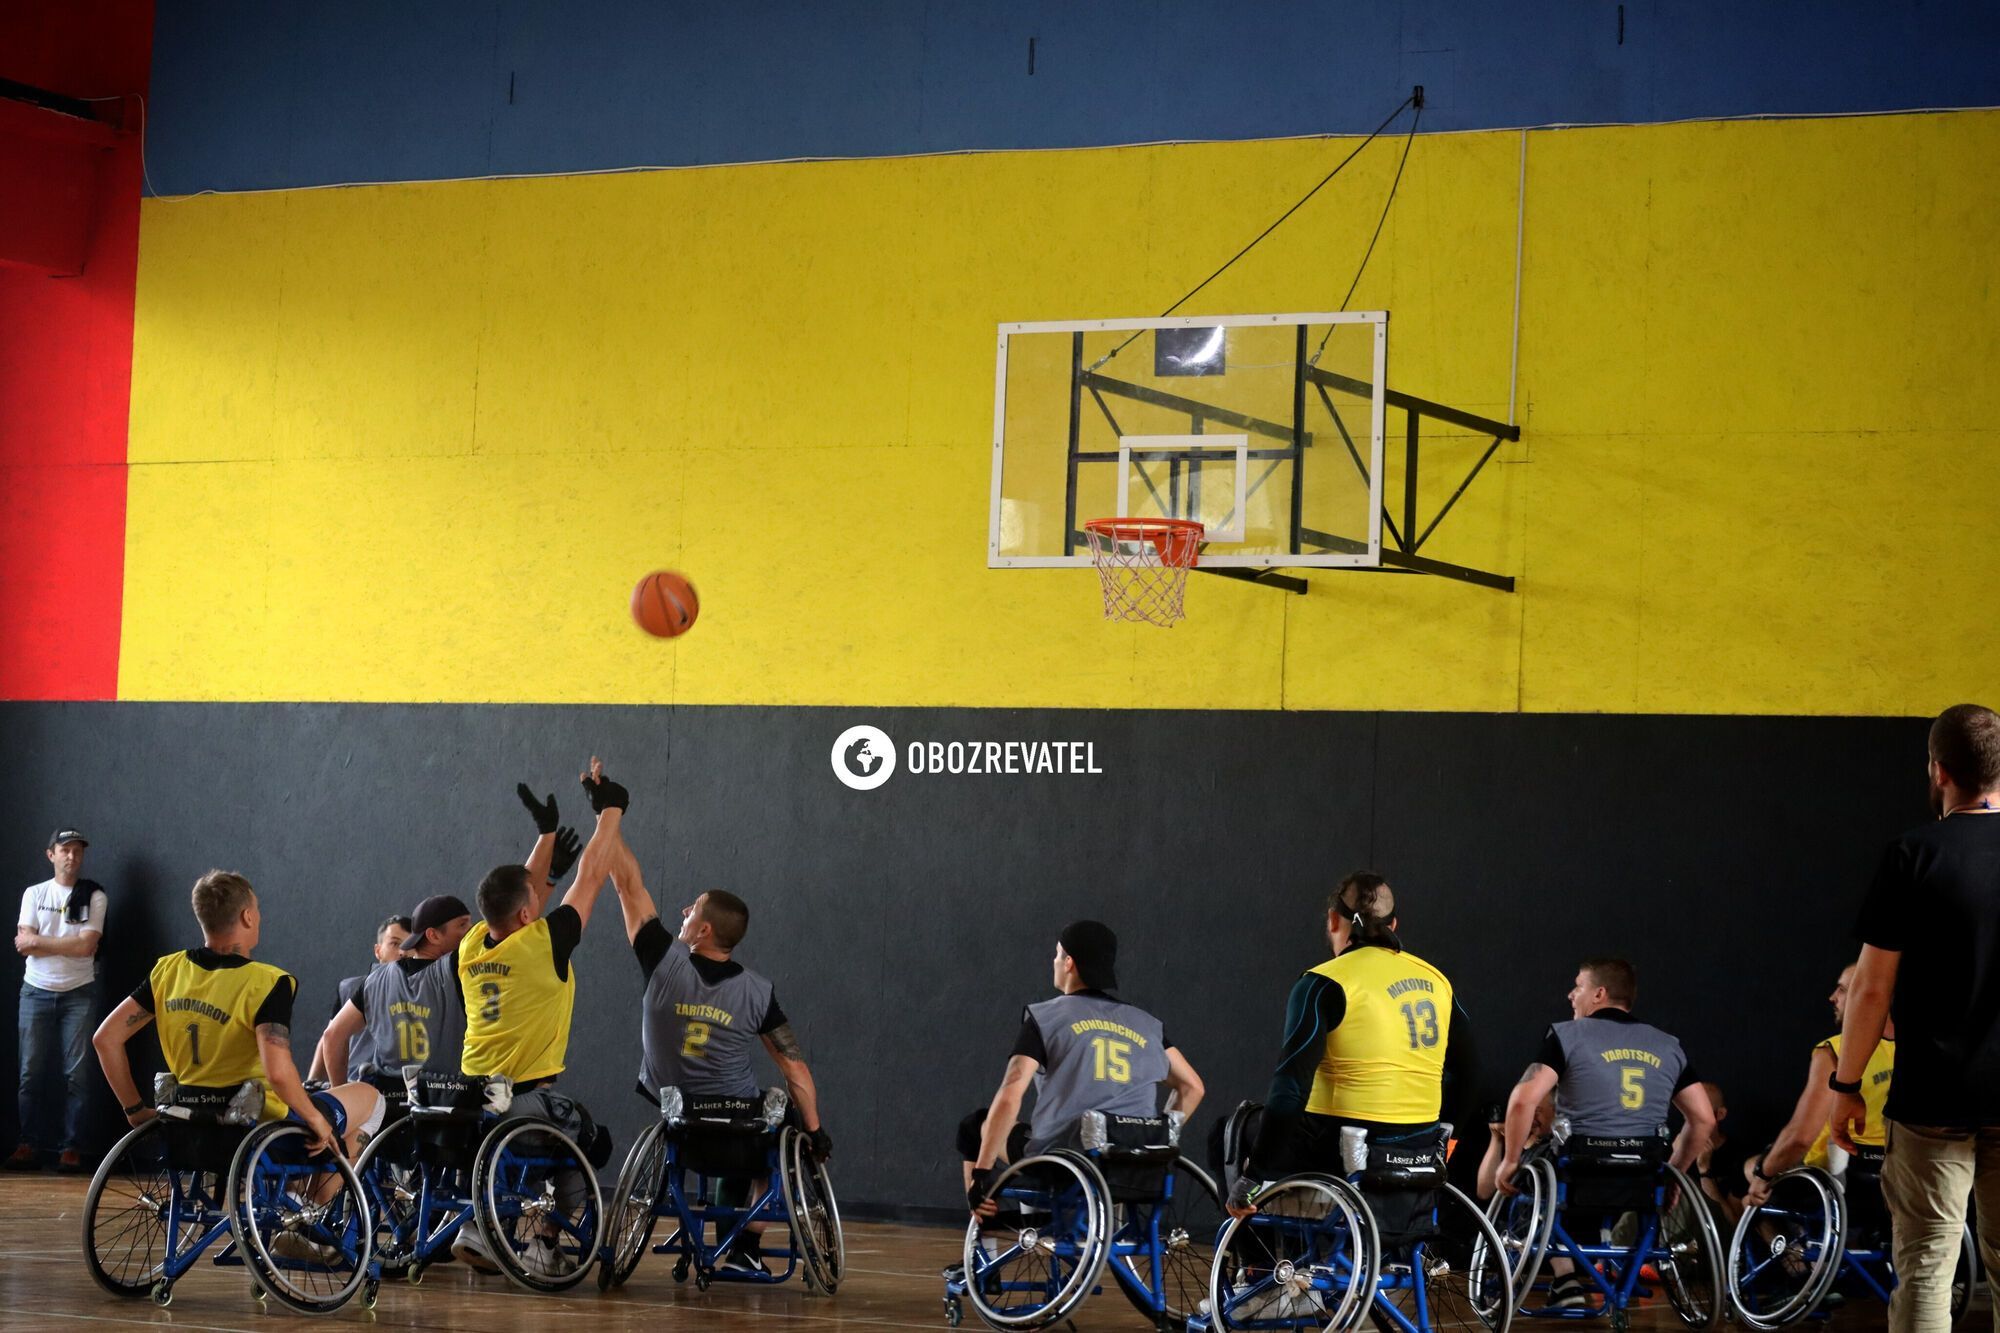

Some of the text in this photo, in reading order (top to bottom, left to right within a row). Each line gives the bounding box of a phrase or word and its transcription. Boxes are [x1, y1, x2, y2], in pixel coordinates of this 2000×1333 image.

[467, 961, 512, 978] LUCHKIV
[1386, 978, 1434, 1000] MAKOVEI
[165, 997, 232, 1026] PONOMAROV
[674, 1003, 733, 1026] ZARITSKYI
[1400, 1000, 1439, 1049] 13
[186, 1023, 200, 1065] 1
[395, 1020, 430, 1062] 16
[681, 1020, 711, 1057] 2
[1071, 1018, 1148, 1049] BONDARCHUK
[1091, 1037, 1132, 1084] 15
[1600, 1048, 1662, 1069] YAROTSKYI
[384, 1089, 409, 1098] LASHE
[1621, 1067, 1646, 1110] 5
